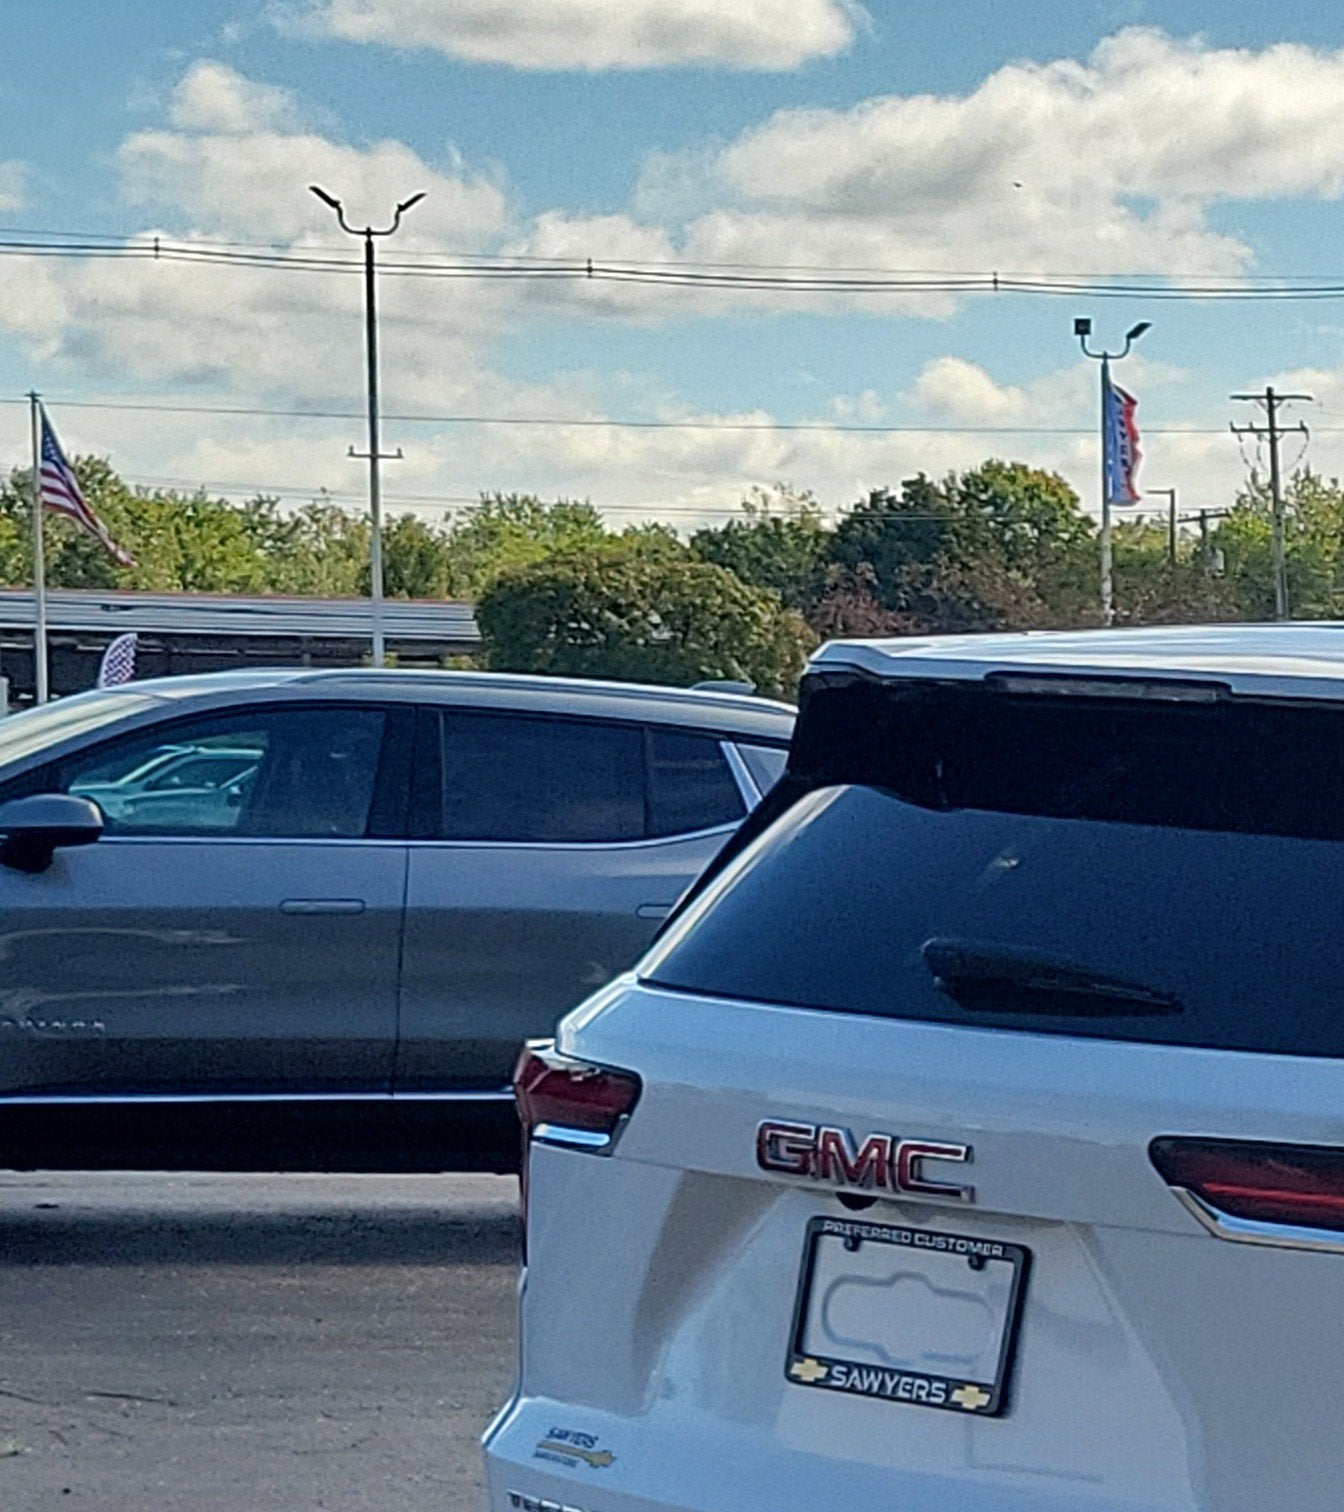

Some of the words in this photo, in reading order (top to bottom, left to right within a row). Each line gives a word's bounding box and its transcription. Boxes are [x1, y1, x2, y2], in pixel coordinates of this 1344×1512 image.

[756, 1117, 976, 1203] GMC
[822, 1219, 912, 1243] PREFERRED
[914, 1234, 1004, 1257] CUSTOMER
[830, 1365, 947, 1404] SAWYERS
